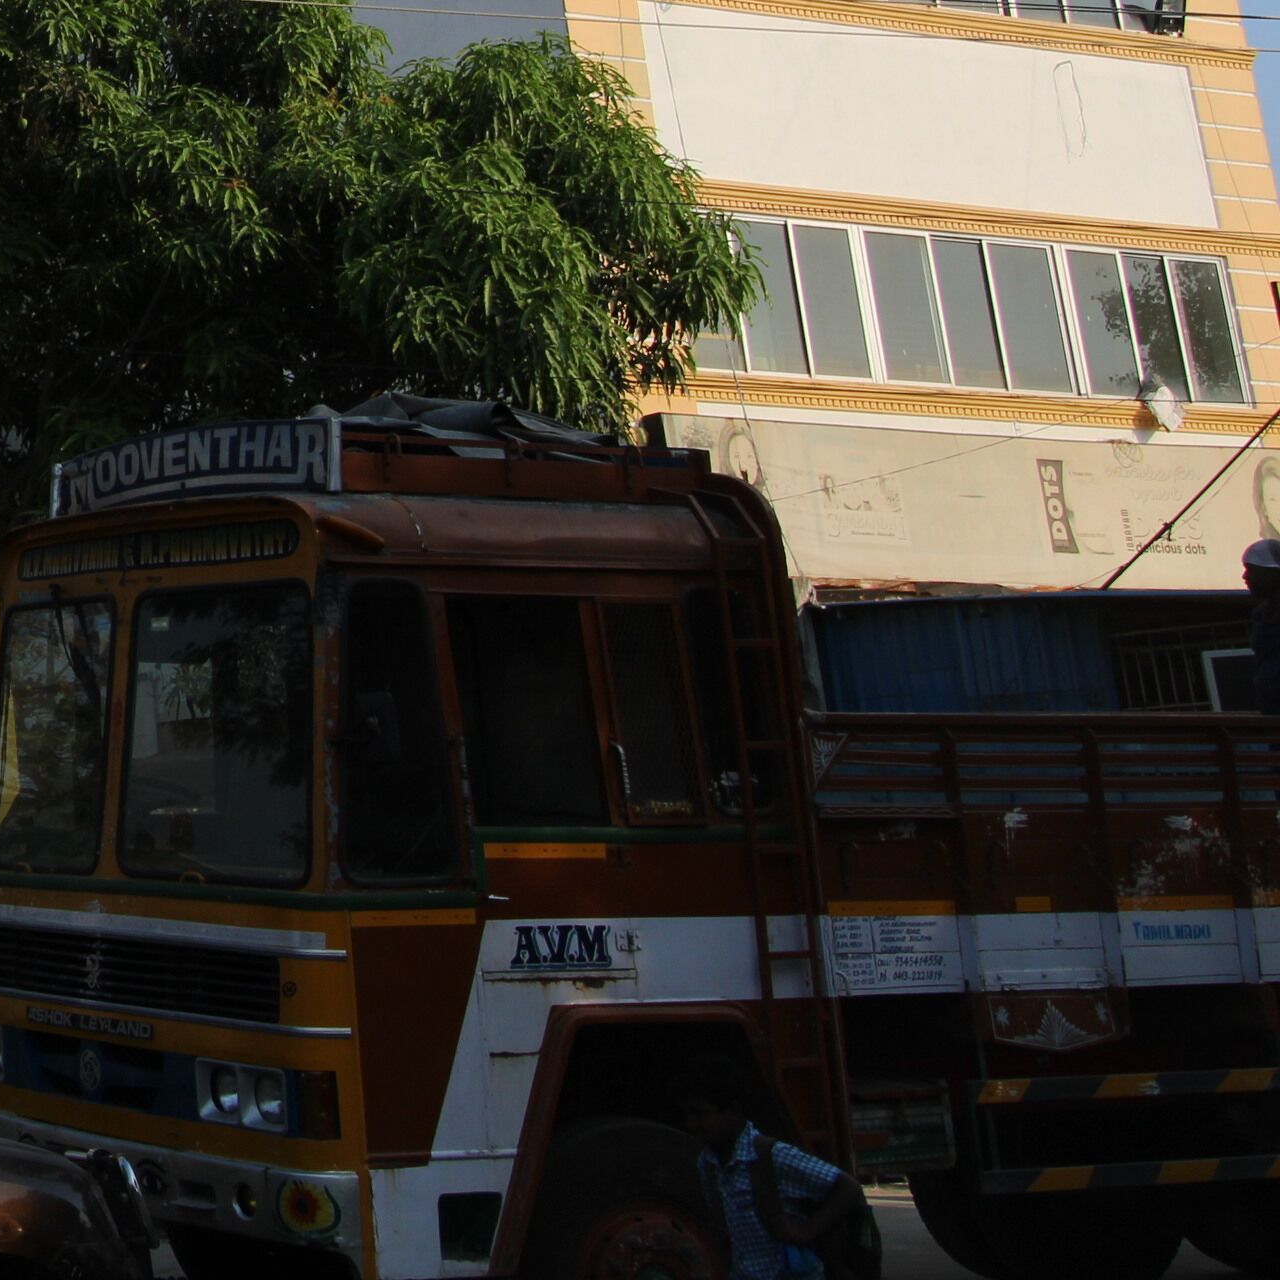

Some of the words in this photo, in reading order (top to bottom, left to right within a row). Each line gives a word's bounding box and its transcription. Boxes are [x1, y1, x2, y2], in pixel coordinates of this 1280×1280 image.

[62, 423, 327, 516] MOOVENTHAR
[1041, 465, 1069, 547] DOTS
[1185, 543, 1207, 555] dots
[510, 925, 613, 969] A.V.M
[1132, 922, 1211, 940] TAMILNADU
[28, 1006, 73, 1028] ASHOK
[79, 1015, 153, 1039] LEYLAND
